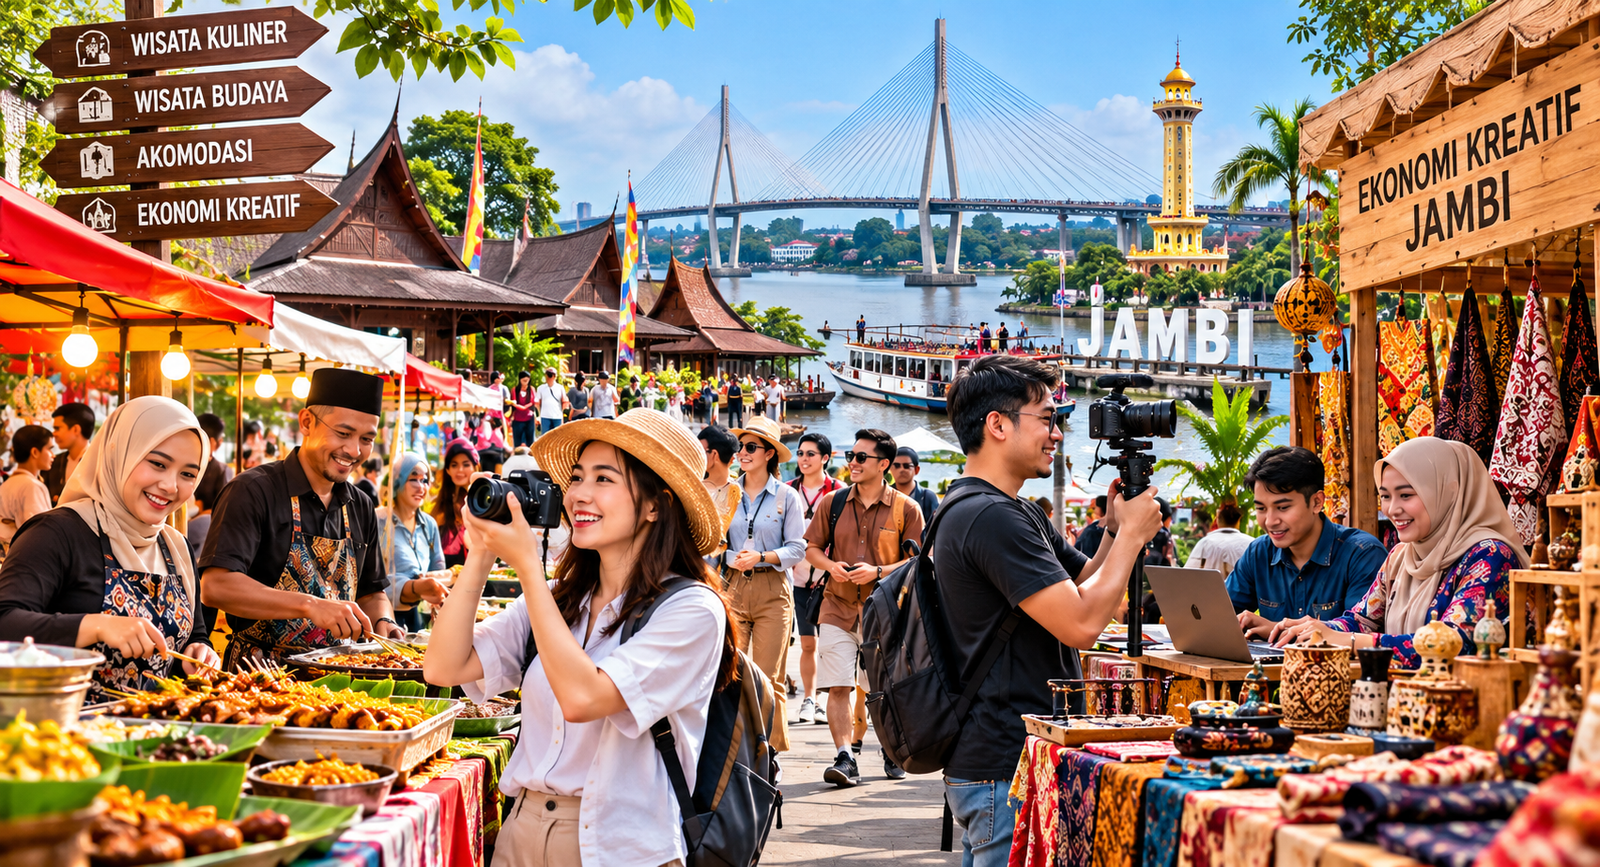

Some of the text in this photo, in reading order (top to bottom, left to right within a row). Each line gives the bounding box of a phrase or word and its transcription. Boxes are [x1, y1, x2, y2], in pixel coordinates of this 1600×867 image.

[130, 20, 287, 56] WISATA KULINER
[134, 80, 288, 113] WISATA BUDAYA
[136, 139, 252, 169] AKOMODASI
[1359, 84, 1581, 214] EKONOMI KREATIF
[137, 194, 300, 226] EKONOMI KREATIF
[1406, 170, 1510, 252] JAMBI
[1077, 306, 1254, 367] JAMBI
